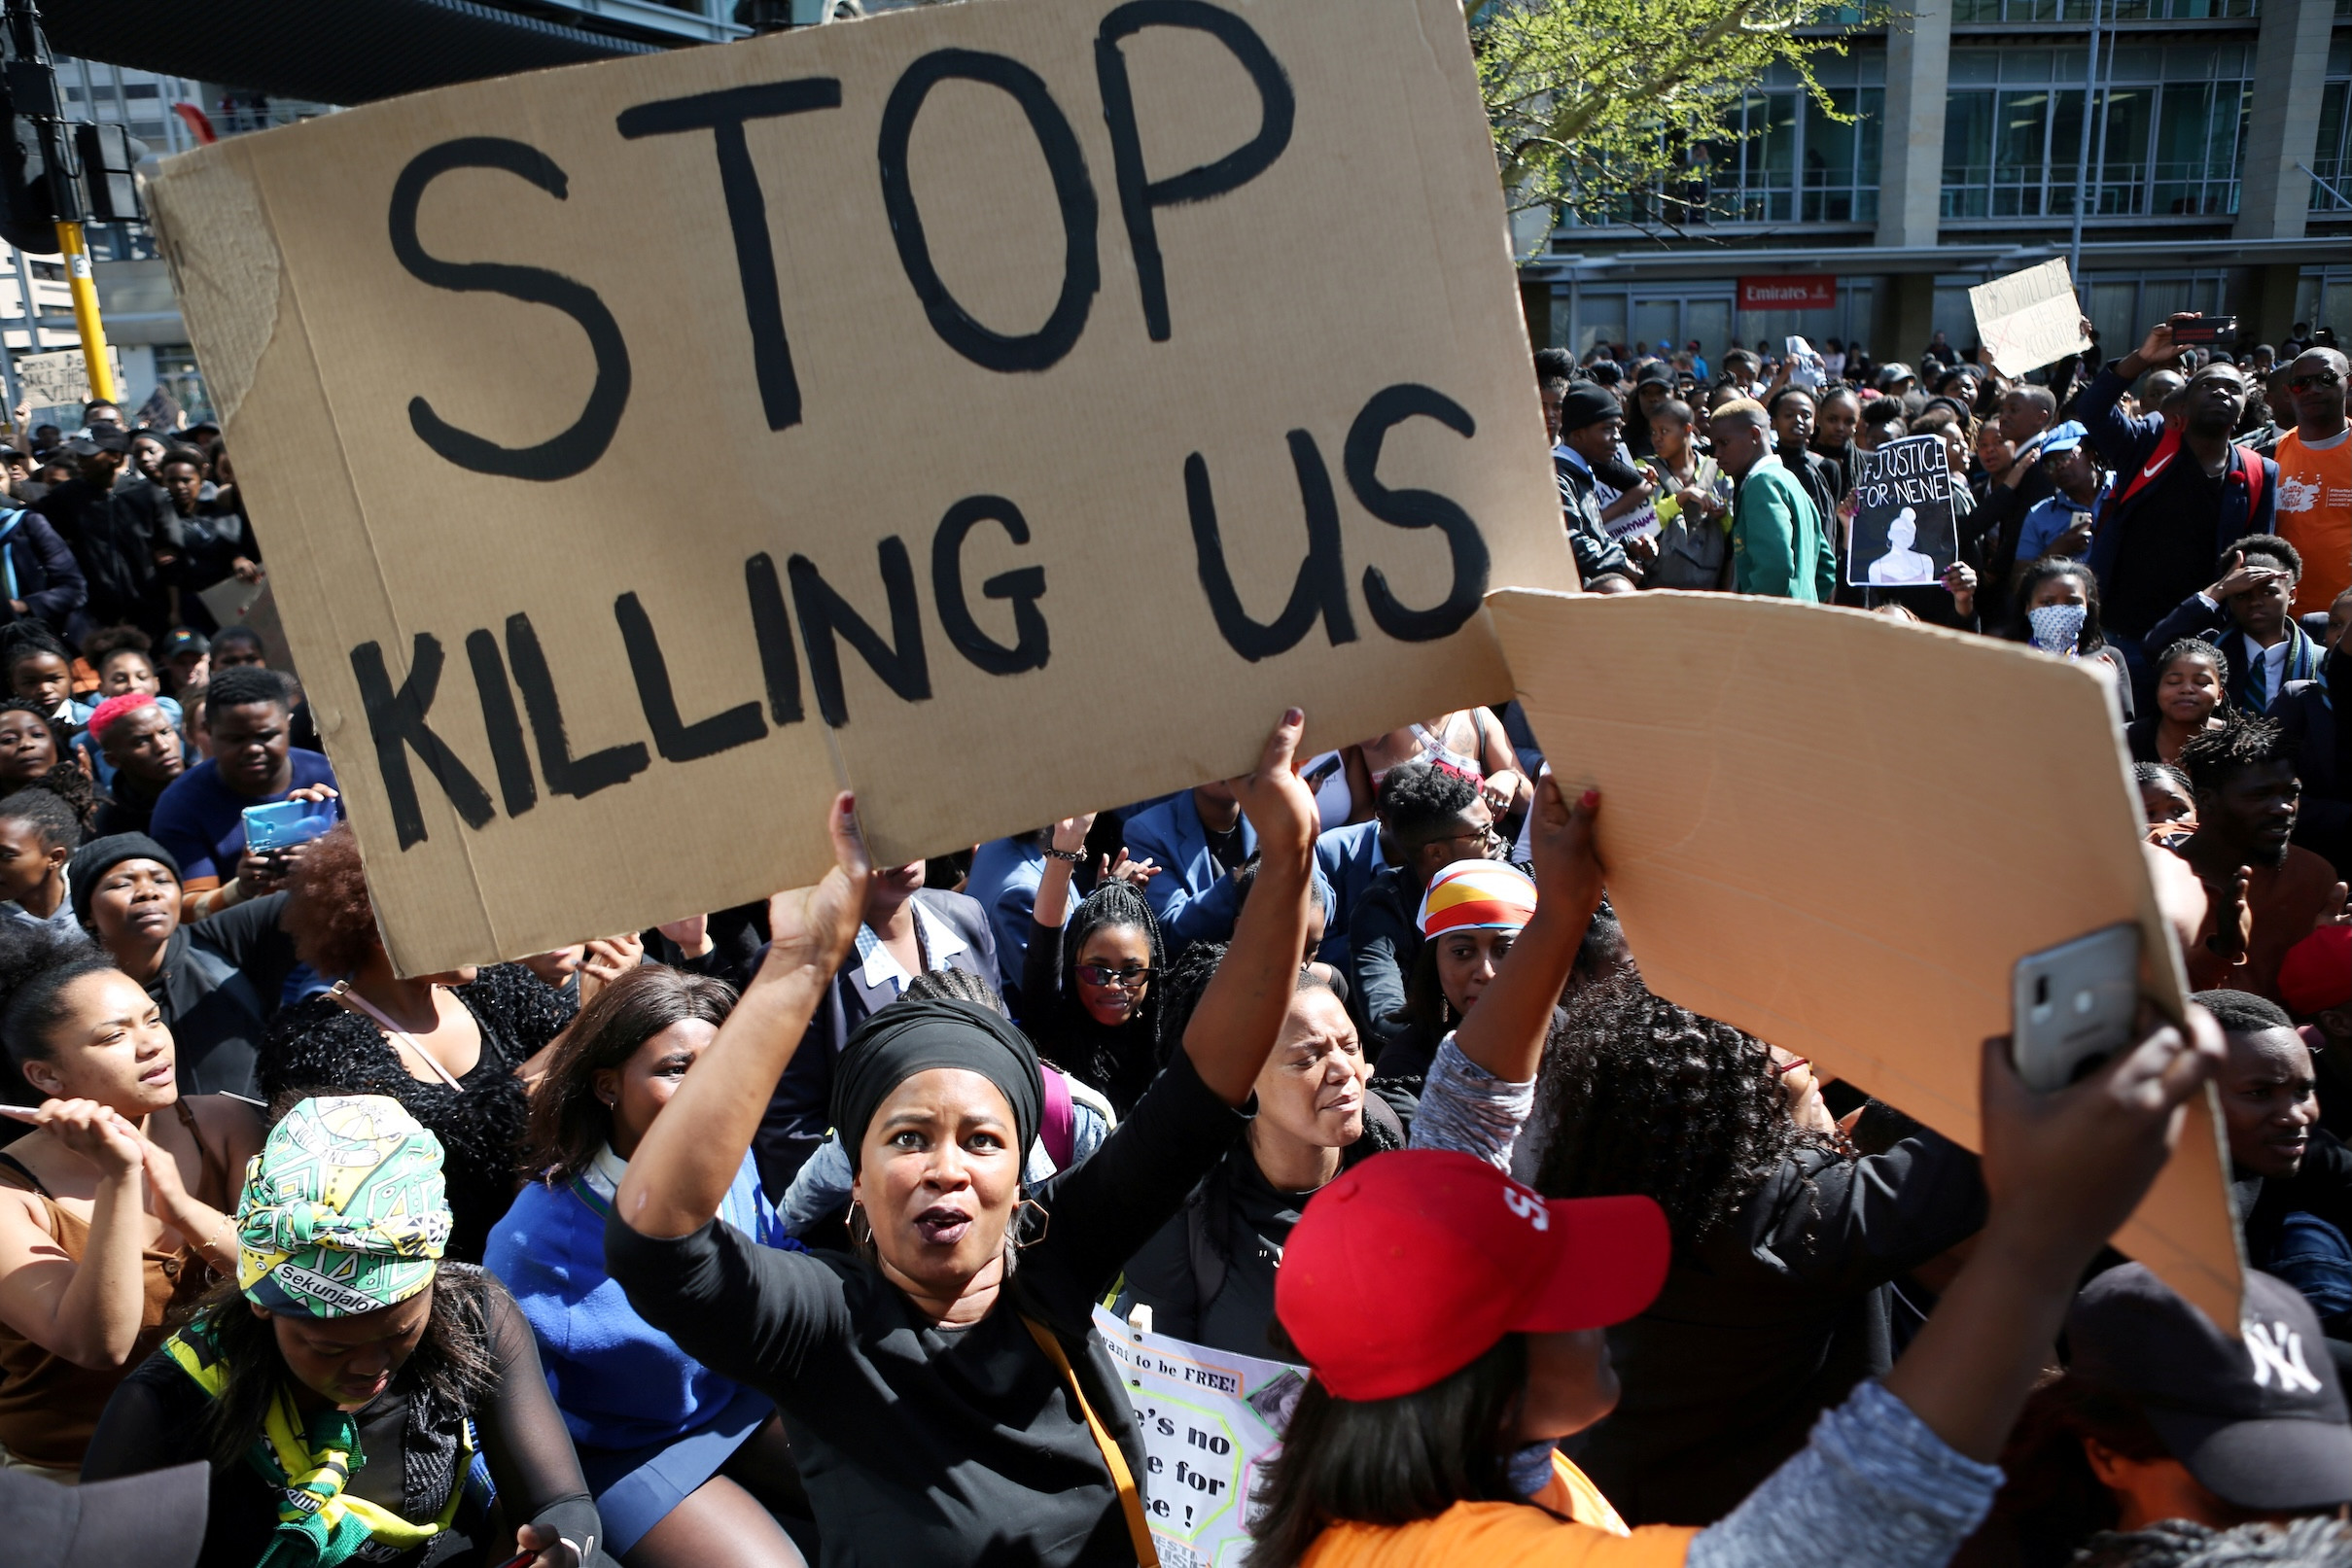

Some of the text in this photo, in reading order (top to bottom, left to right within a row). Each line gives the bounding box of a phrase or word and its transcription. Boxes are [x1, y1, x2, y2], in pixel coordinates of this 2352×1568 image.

[389, 0, 1294, 481] STOP
[1746, 285, 1808, 301] Emirates
[2012, 271, 2045, 307] WILL
[1857, 472, 1950, 508] FOR NENE
[351, 382, 1490, 852] KILLING US
[319, 1148, 349, 1165] ANC
[1503, 1185, 1550, 1233] S
[398, 1231, 431, 1258] AN
[280, 1266, 379, 1312] Sekunjalo!
[2240, 1313, 2323, 1394] NY
[1136, 1354, 1151, 1370] to
[1159, 1360, 1176, 1377] be
[1184, 1367, 1237, 1394] FREE!
[1187, 1426, 1231, 1456] no
[1147, 1455, 1226, 1497] e for
